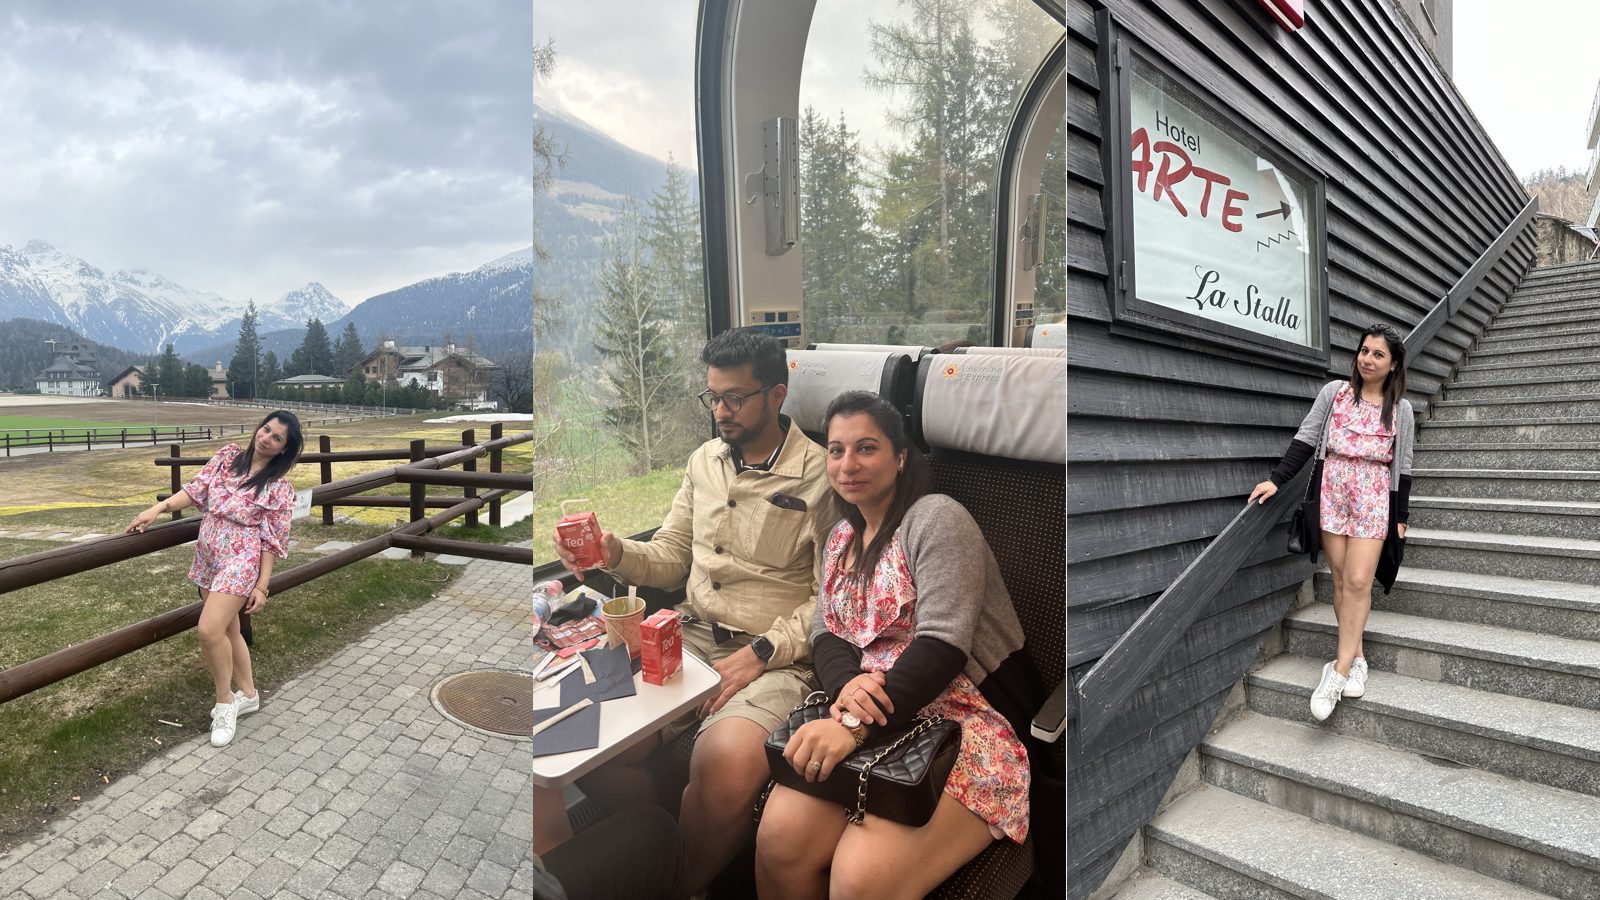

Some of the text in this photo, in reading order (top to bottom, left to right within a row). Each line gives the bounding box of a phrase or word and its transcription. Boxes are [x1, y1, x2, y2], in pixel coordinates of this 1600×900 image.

[1156, 111, 1201, 154] Hotel
[1131, 127, 1249, 232] ARTE
[1185, 264, 1301, 330] La Stalla
[564, 538, 584, 548] Tea
[662, 635, 675, 652] Tea
